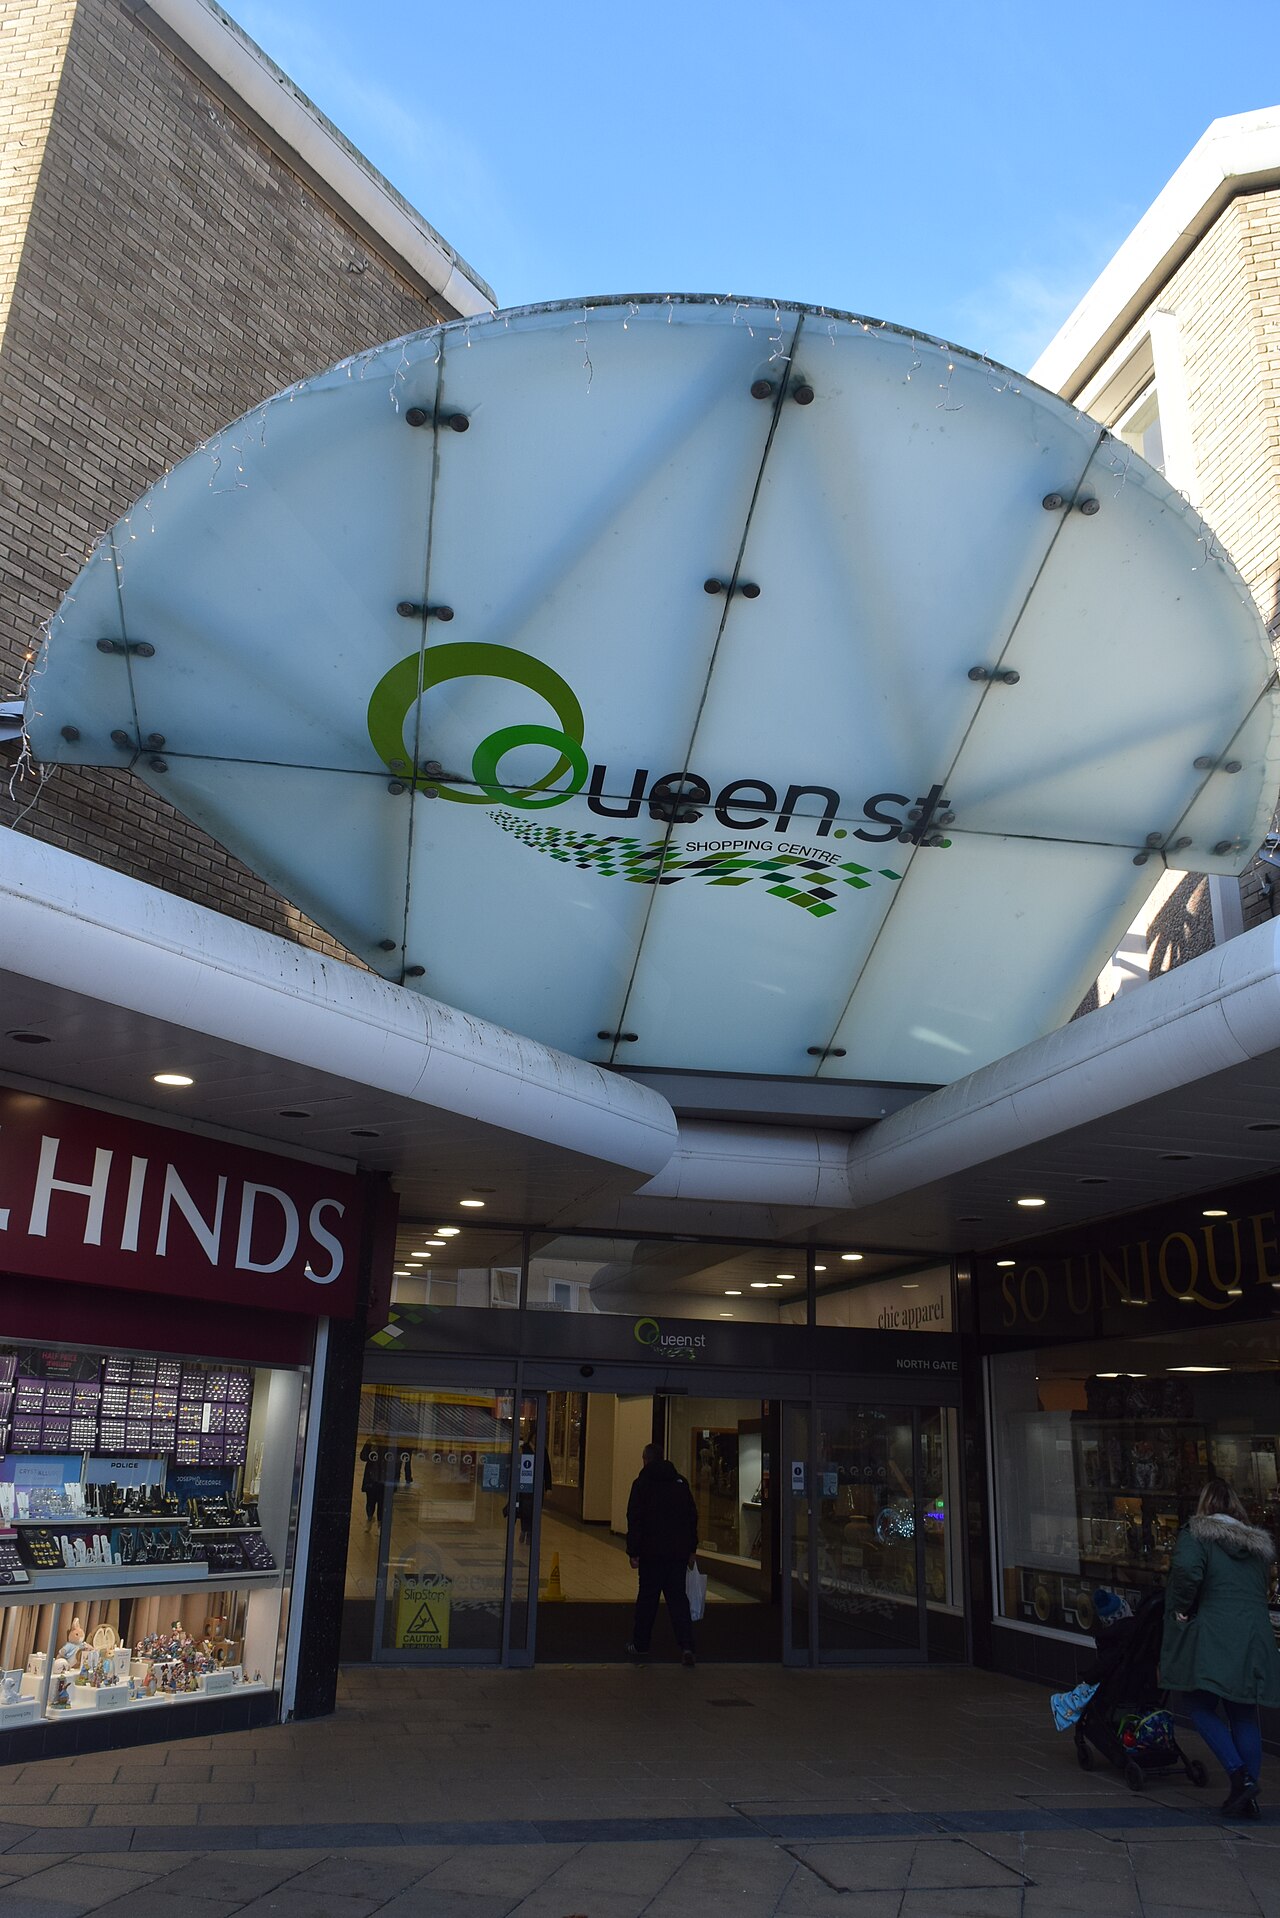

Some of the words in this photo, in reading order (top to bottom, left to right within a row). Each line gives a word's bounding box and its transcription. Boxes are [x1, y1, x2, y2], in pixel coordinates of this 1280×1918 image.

[685, 840, 773, 852] SHOPPING
[777, 842, 842, 865] CENTRE
[1001, 1266, 1049, 1328] SO
[1064, 1210, 1280, 1315] UNIQUE
[878, 1305, 900, 1330] chic
[901, 1295, 944, 1330] apparel
[896, 1359, 930, 1369] NORTH
[932, 1360, 959, 1371] GATE
[404, 1588, 445, 1604] SlipStop
[403, 1635, 442, 1643] CAUTION
